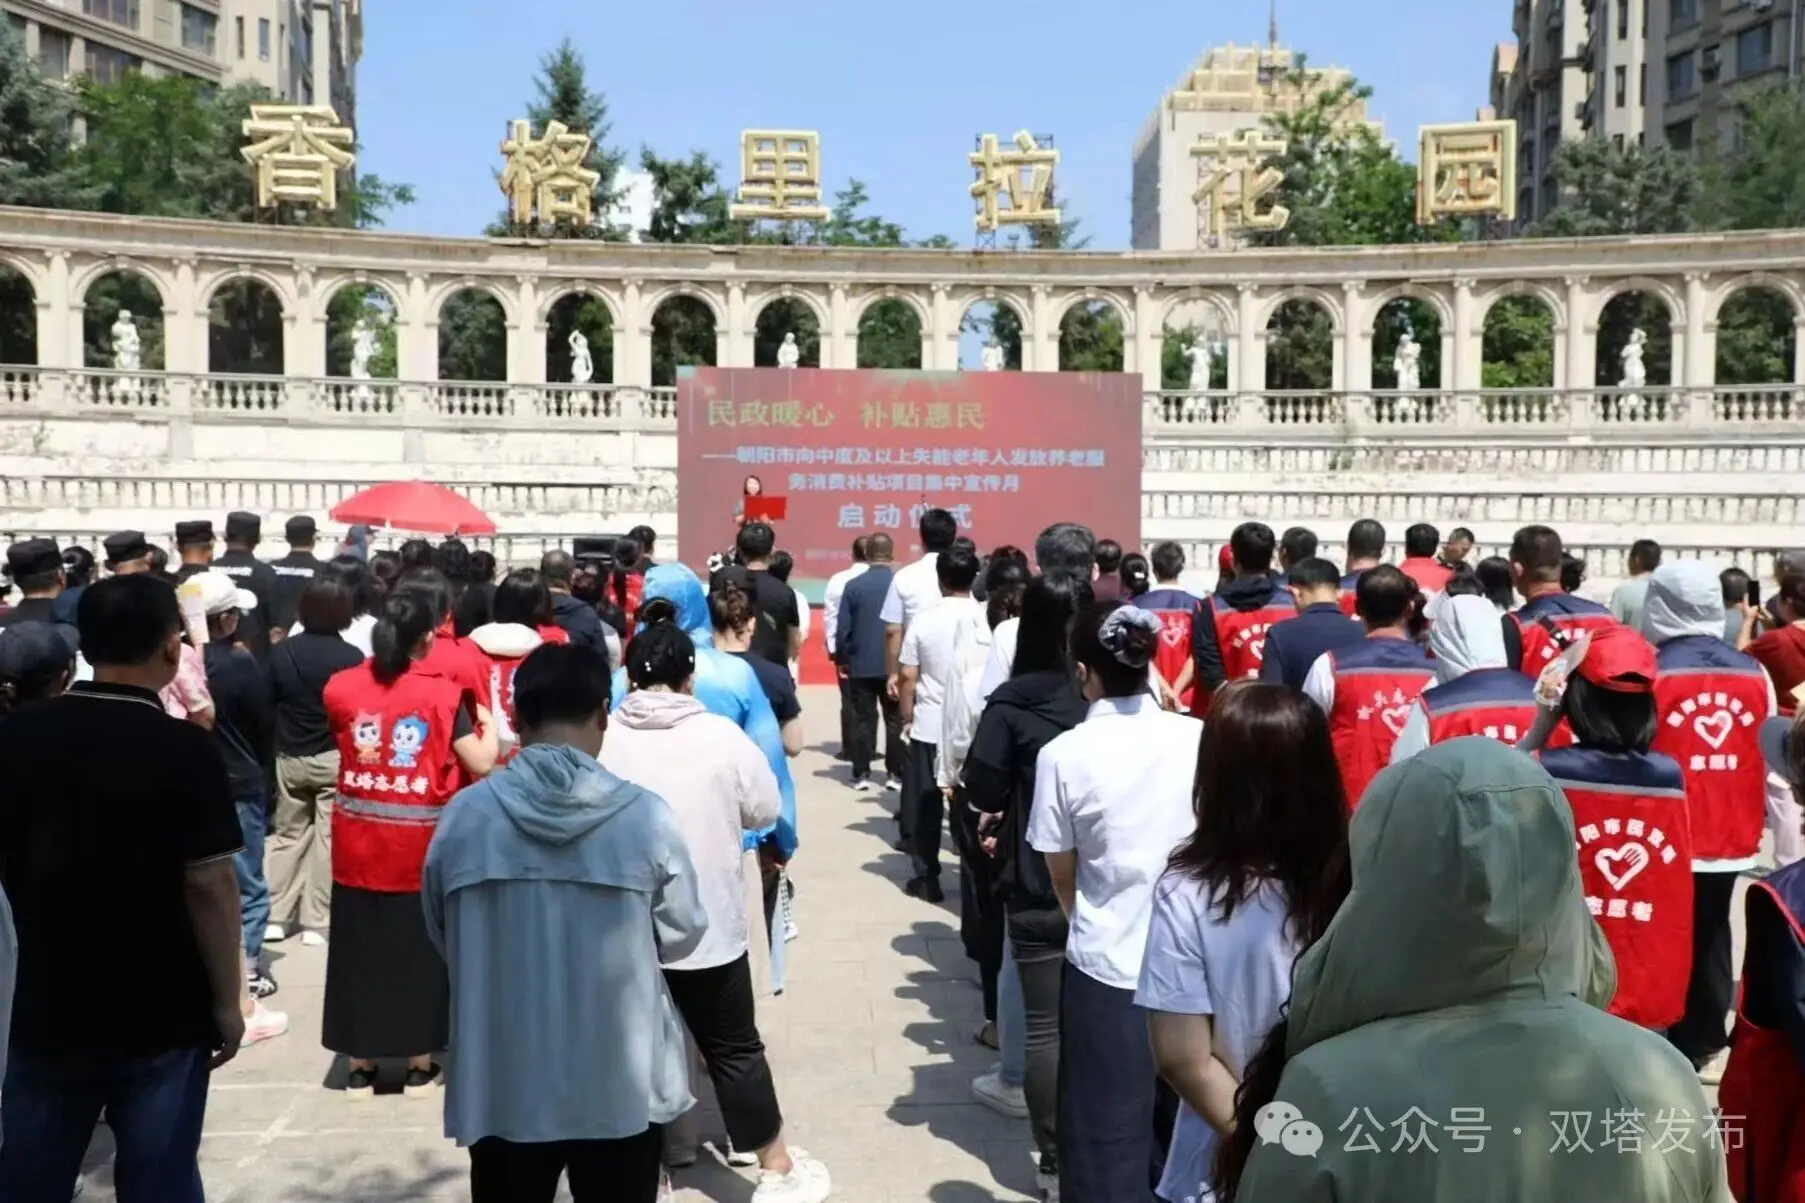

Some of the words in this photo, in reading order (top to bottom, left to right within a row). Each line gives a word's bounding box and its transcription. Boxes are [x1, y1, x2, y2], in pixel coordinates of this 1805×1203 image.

[707, 400, 836, 428] 民政暖心
[859, 402, 985, 431] 补贴惠民
